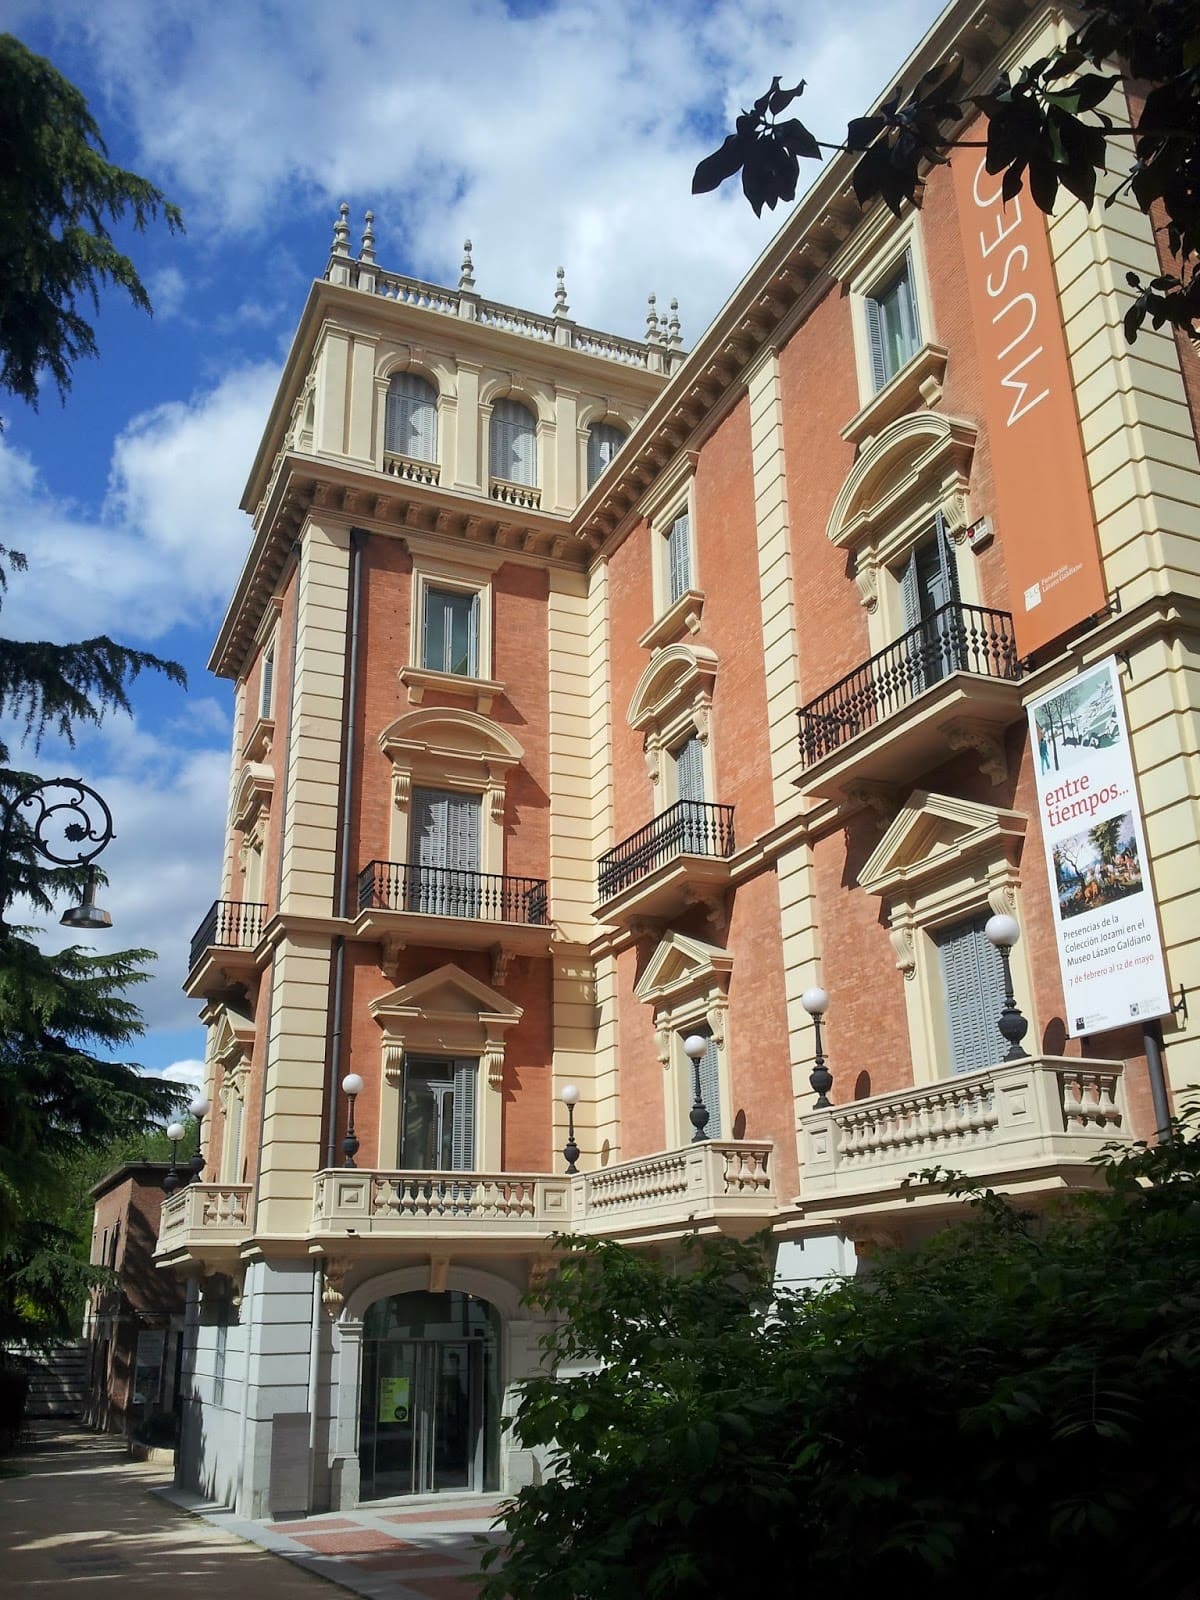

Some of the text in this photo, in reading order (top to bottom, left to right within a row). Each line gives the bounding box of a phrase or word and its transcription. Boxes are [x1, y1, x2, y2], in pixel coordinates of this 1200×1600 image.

[1045, 775, 1090, 807] entre
[1047, 783, 1128, 827] tiempos...
[1063, 914, 1119, 940] Presencias de la
[1099, 927, 1125, 943] Jozami
[1126, 923, 1137, 933] en
[1137, 919, 1145, 929] el
[1066, 933, 1151, 968] Museo Lázaro Galdiano
[1068, 978, 1073, 987] 7
[1074, 974, 1082, 984] de
[1083, 968, 1107, 981] febrero
[1108, 964, 1115, 973] al
[1124, 959, 1133, 968] de
[1134, 953, 1154, 966] mayo
